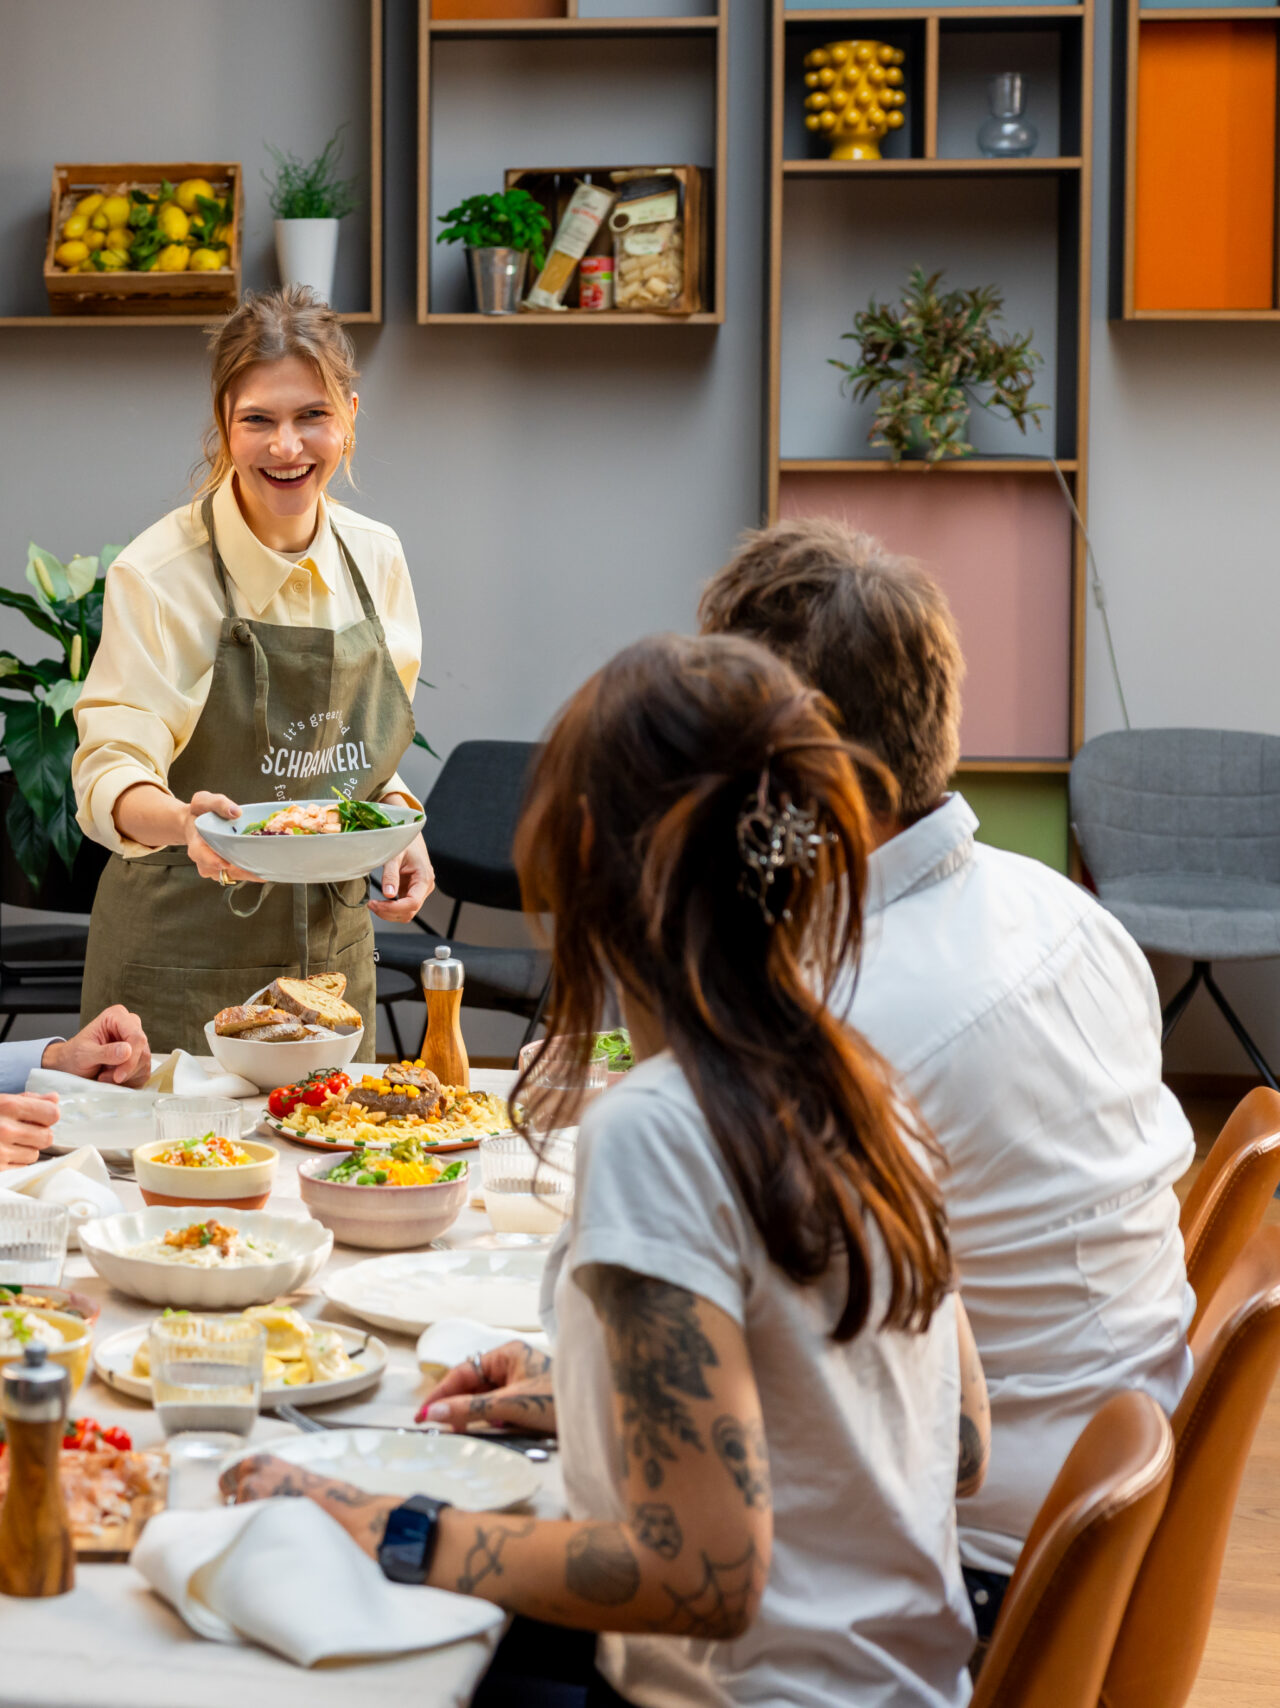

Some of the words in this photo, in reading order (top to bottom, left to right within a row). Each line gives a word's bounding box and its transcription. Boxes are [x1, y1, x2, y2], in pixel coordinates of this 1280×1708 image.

[282, 721, 306, 741] it's
[309, 710, 339, 728] great
[260, 740, 372, 778] SCHRANKERL
